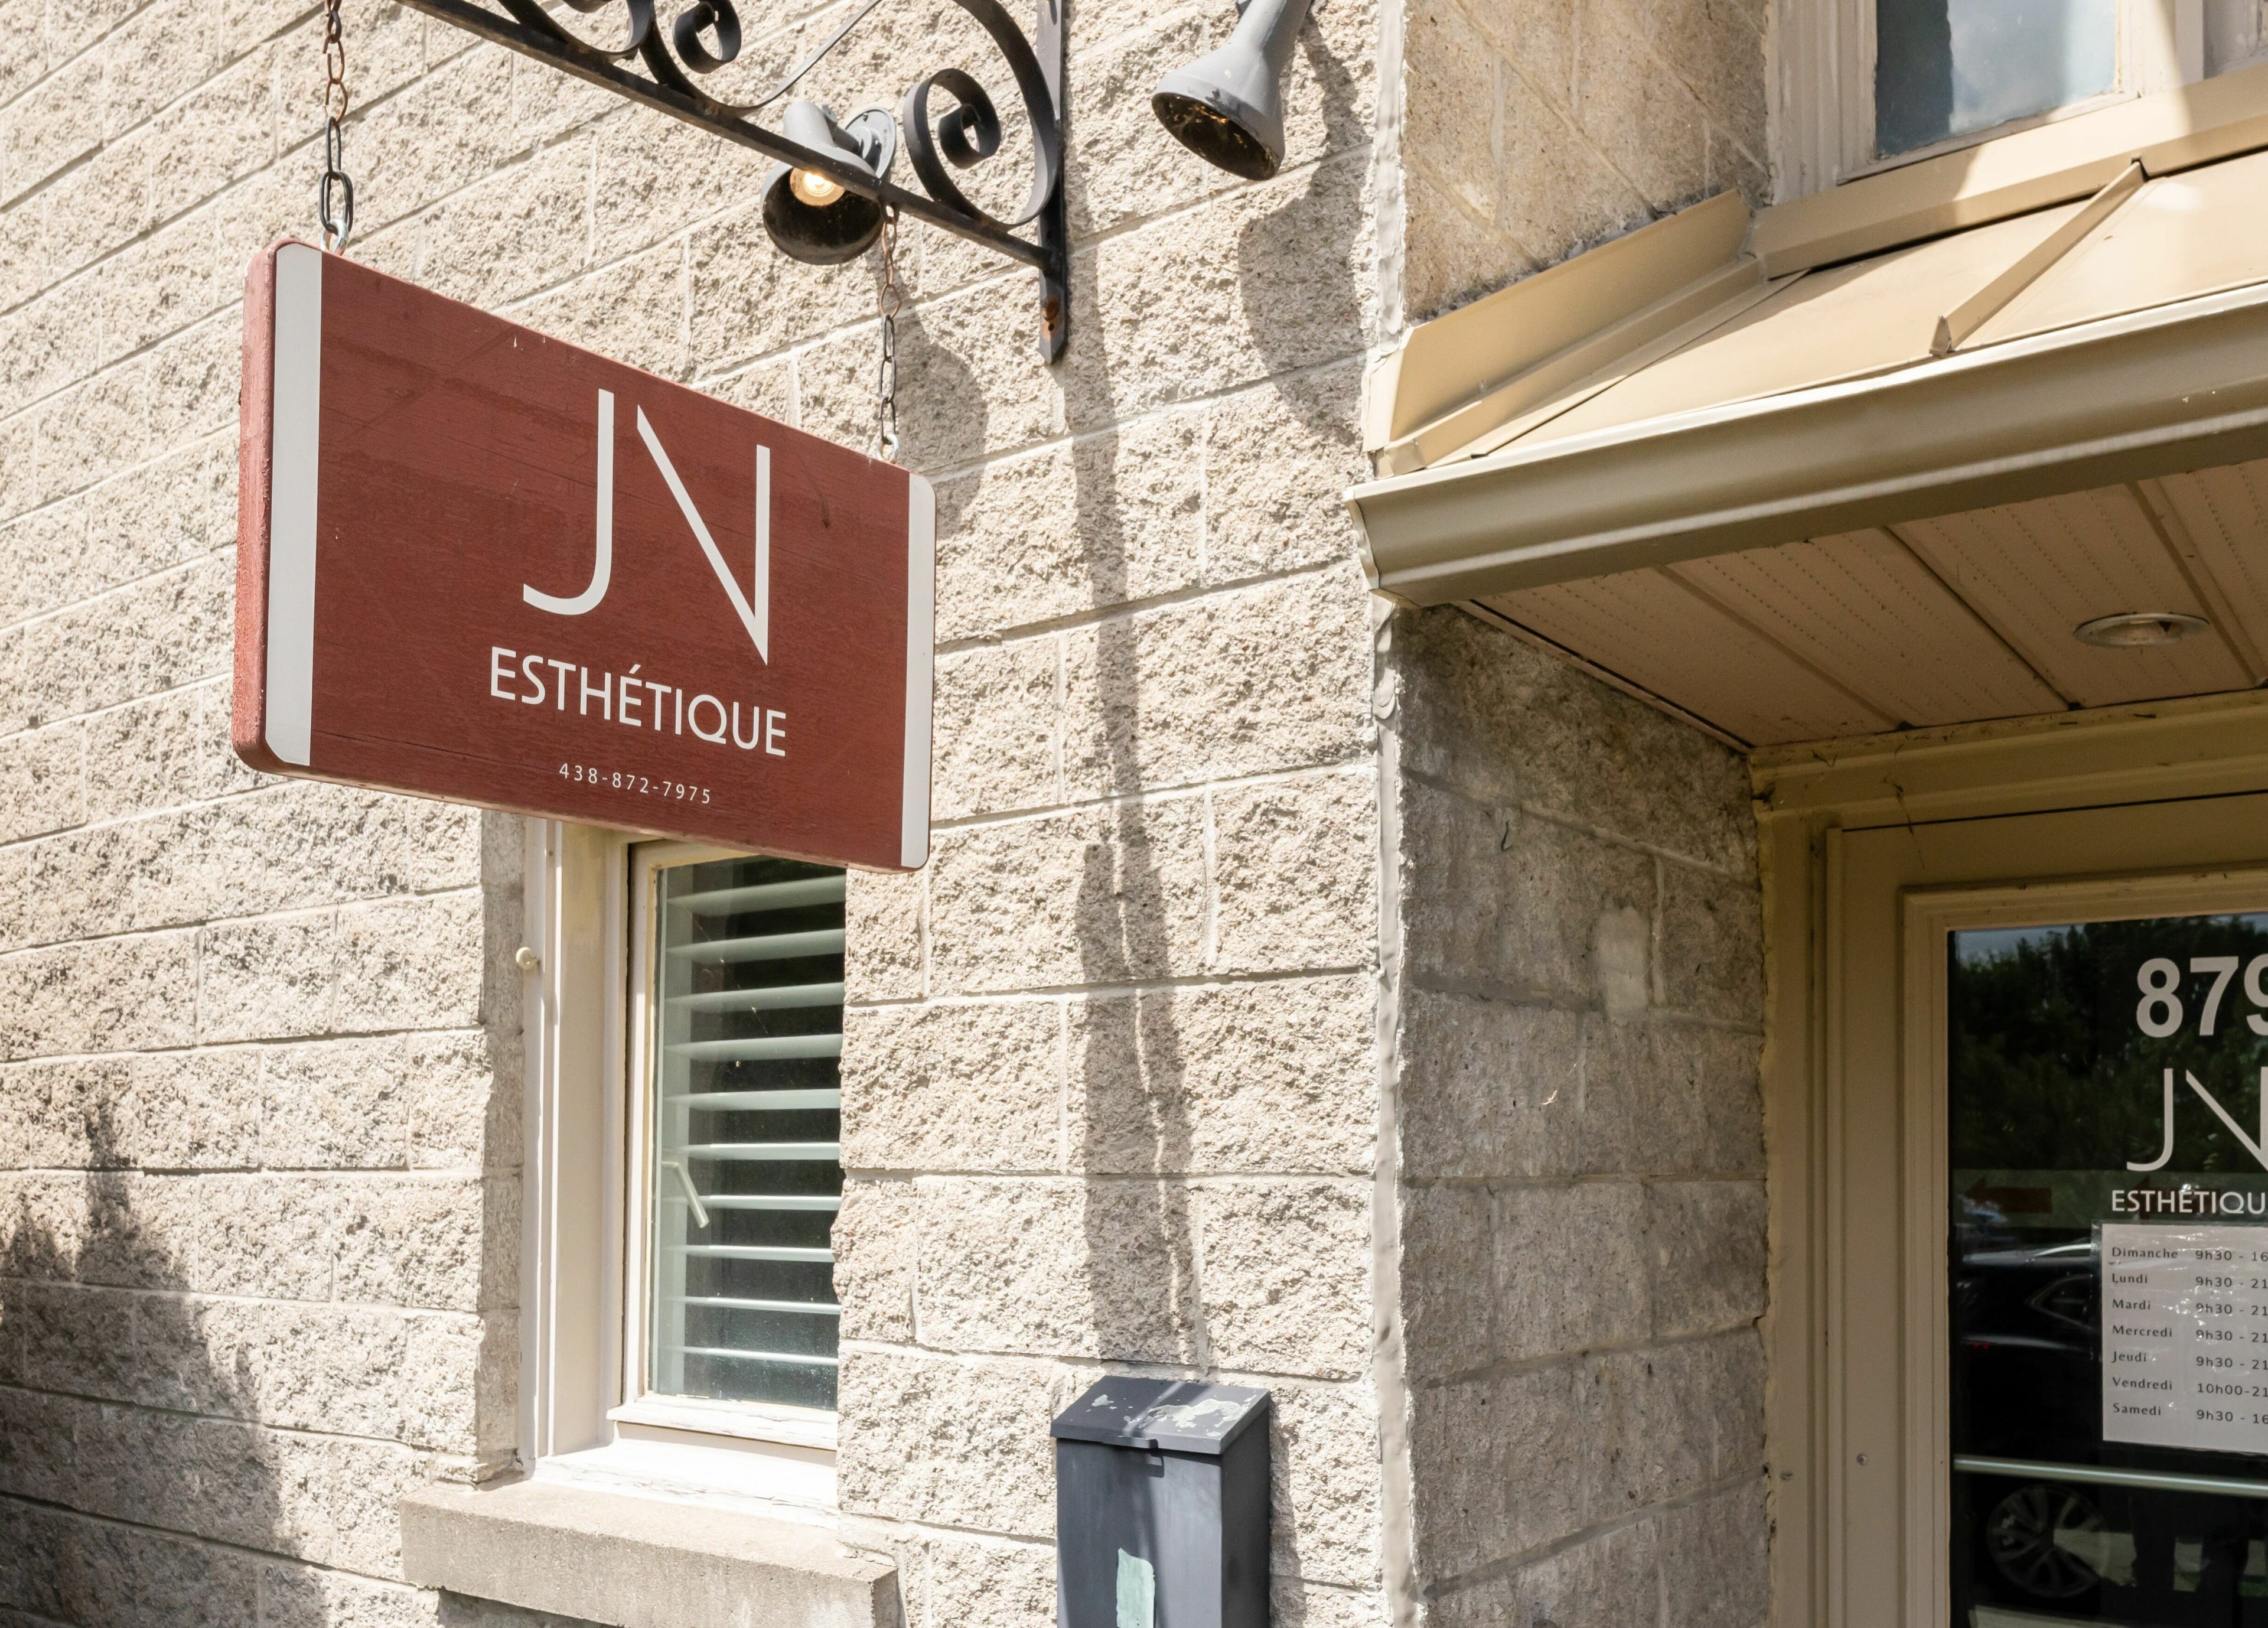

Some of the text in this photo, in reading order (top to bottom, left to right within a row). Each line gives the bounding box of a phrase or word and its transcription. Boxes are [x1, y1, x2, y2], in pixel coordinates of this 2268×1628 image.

[523, 388, 770, 666] JN
[490, 646, 786, 757] ESTHÉTIQUE
[559, 763, 711, 804] 438-872-7975
[2126, 1067, 2268, 1172] JN
[2111, 1246, 2178, 1259] Dimanche
[2195, 1250, 2233, 1261] 9h30
[2111, 1272, 2148, 1284] Lundi
[2195, 1276, 2233, 1288] 9h30
[2112, 1298, 2151, 1310] Mardi
[2195, 1303, 2233, 1314] 9h30
[2112, 1324, 2172, 1337] Mercredi
[2195, 1329, 2233, 1341] 9h30
[2110, 1350, 2147, 1363] Jeudi
[2196, 1356, 2233, 1368] 9h30
[2112, 1376, 2173, 1391] Vendredi
[2113, 1402, 2162, 1416] Samedi
[2196, 1409, 2234, 1422] 9h30
